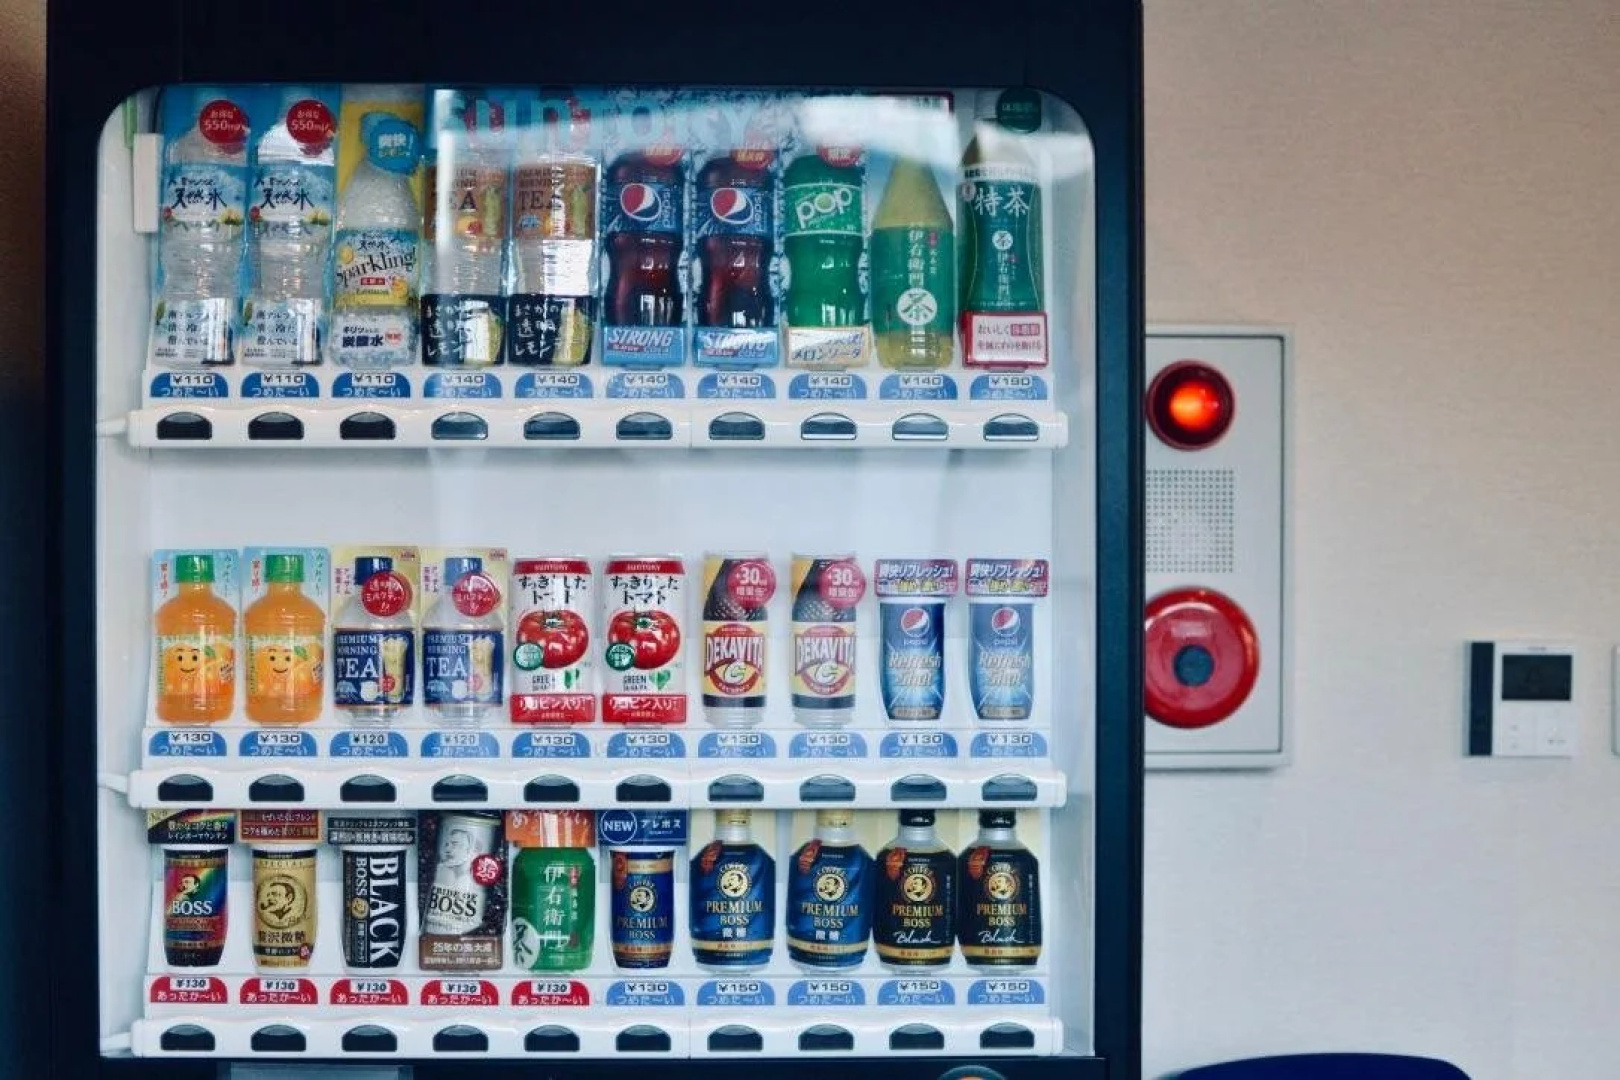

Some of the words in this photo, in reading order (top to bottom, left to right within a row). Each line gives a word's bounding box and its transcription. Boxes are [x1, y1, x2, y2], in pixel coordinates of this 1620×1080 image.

[975, 186, 1029, 217] 特茶
[797, 188, 852, 228] pop
[608, 328, 673, 346] STRONG
[173, 376, 212, 384] ¥110
[264, 376, 303, 384] ¥110
[354, 376, 394, 384] ¥110
[445, 376, 484, 384] ¥140
[538, 376, 578, 384] ¥140
[627, 376, 666, 384] ¥140
[720, 376, 760, 385] ¥140
[810, 376, 851, 385] ¥140
[902, 376, 942, 385] ¥140
[624, 591, 665, 604] トマト
[706, 637, 764, 671] DEKAVITA
[796, 637, 855, 672] DEKAVITA
[337, 658, 378, 677] TEA
[427, 658, 467, 676] TEA
[171, 734, 211, 742] ¥130
[260, 734, 300, 742] ¥130
[354, 735, 384, 743] ¥120
[444, 735, 476, 743] ¥120
[534, 735, 574, 744] ¥130
[627, 735, 667, 744] ¥130
[719, 735, 759, 744] ¥130
[809, 735, 848, 744] ¥130
[900, 735, 942, 743] ¥130
[990, 735, 1031, 743] ¥130
[604, 820, 633, 831] NEW
[356, 857, 367, 895] BOSS
[172, 901, 212, 914] BOSS
[370, 856, 399, 963] BLACK
[430, 894, 476, 916] BOSS
[706, 901, 763, 914] PREMIUM
[977, 904, 1027, 915] PREMIUM
[801, 904, 859, 916] PREMIUM
[892, 905, 943, 917] PREMIUM
[617, 917, 667, 928] PREMIUM
[719, 915, 749, 925] BOSS
[813, 918, 843, 929] BOSS
[903, 918, 931, 927] BOSS
[988, 916, 1016, 926] BOSS
[629, 931, 656, 939] BOSS
[893, 929, 941, 944] Black
[978, 929, 1024, 944] Black
[176, 980, 206, 988] ¥130
[266, 982, 294, 990] ¥130
[357, 983, 387, 992] ¥130
[447, 984, 476, 993] ¥130
[537, 984, 567, 992] ¥130
[627, 984, 667, 992] ¥130
[718, 983, 758, 992] ¥150
[810, 983, 849, 992] ¥150
[900, 982, 939, 990] ¥150
